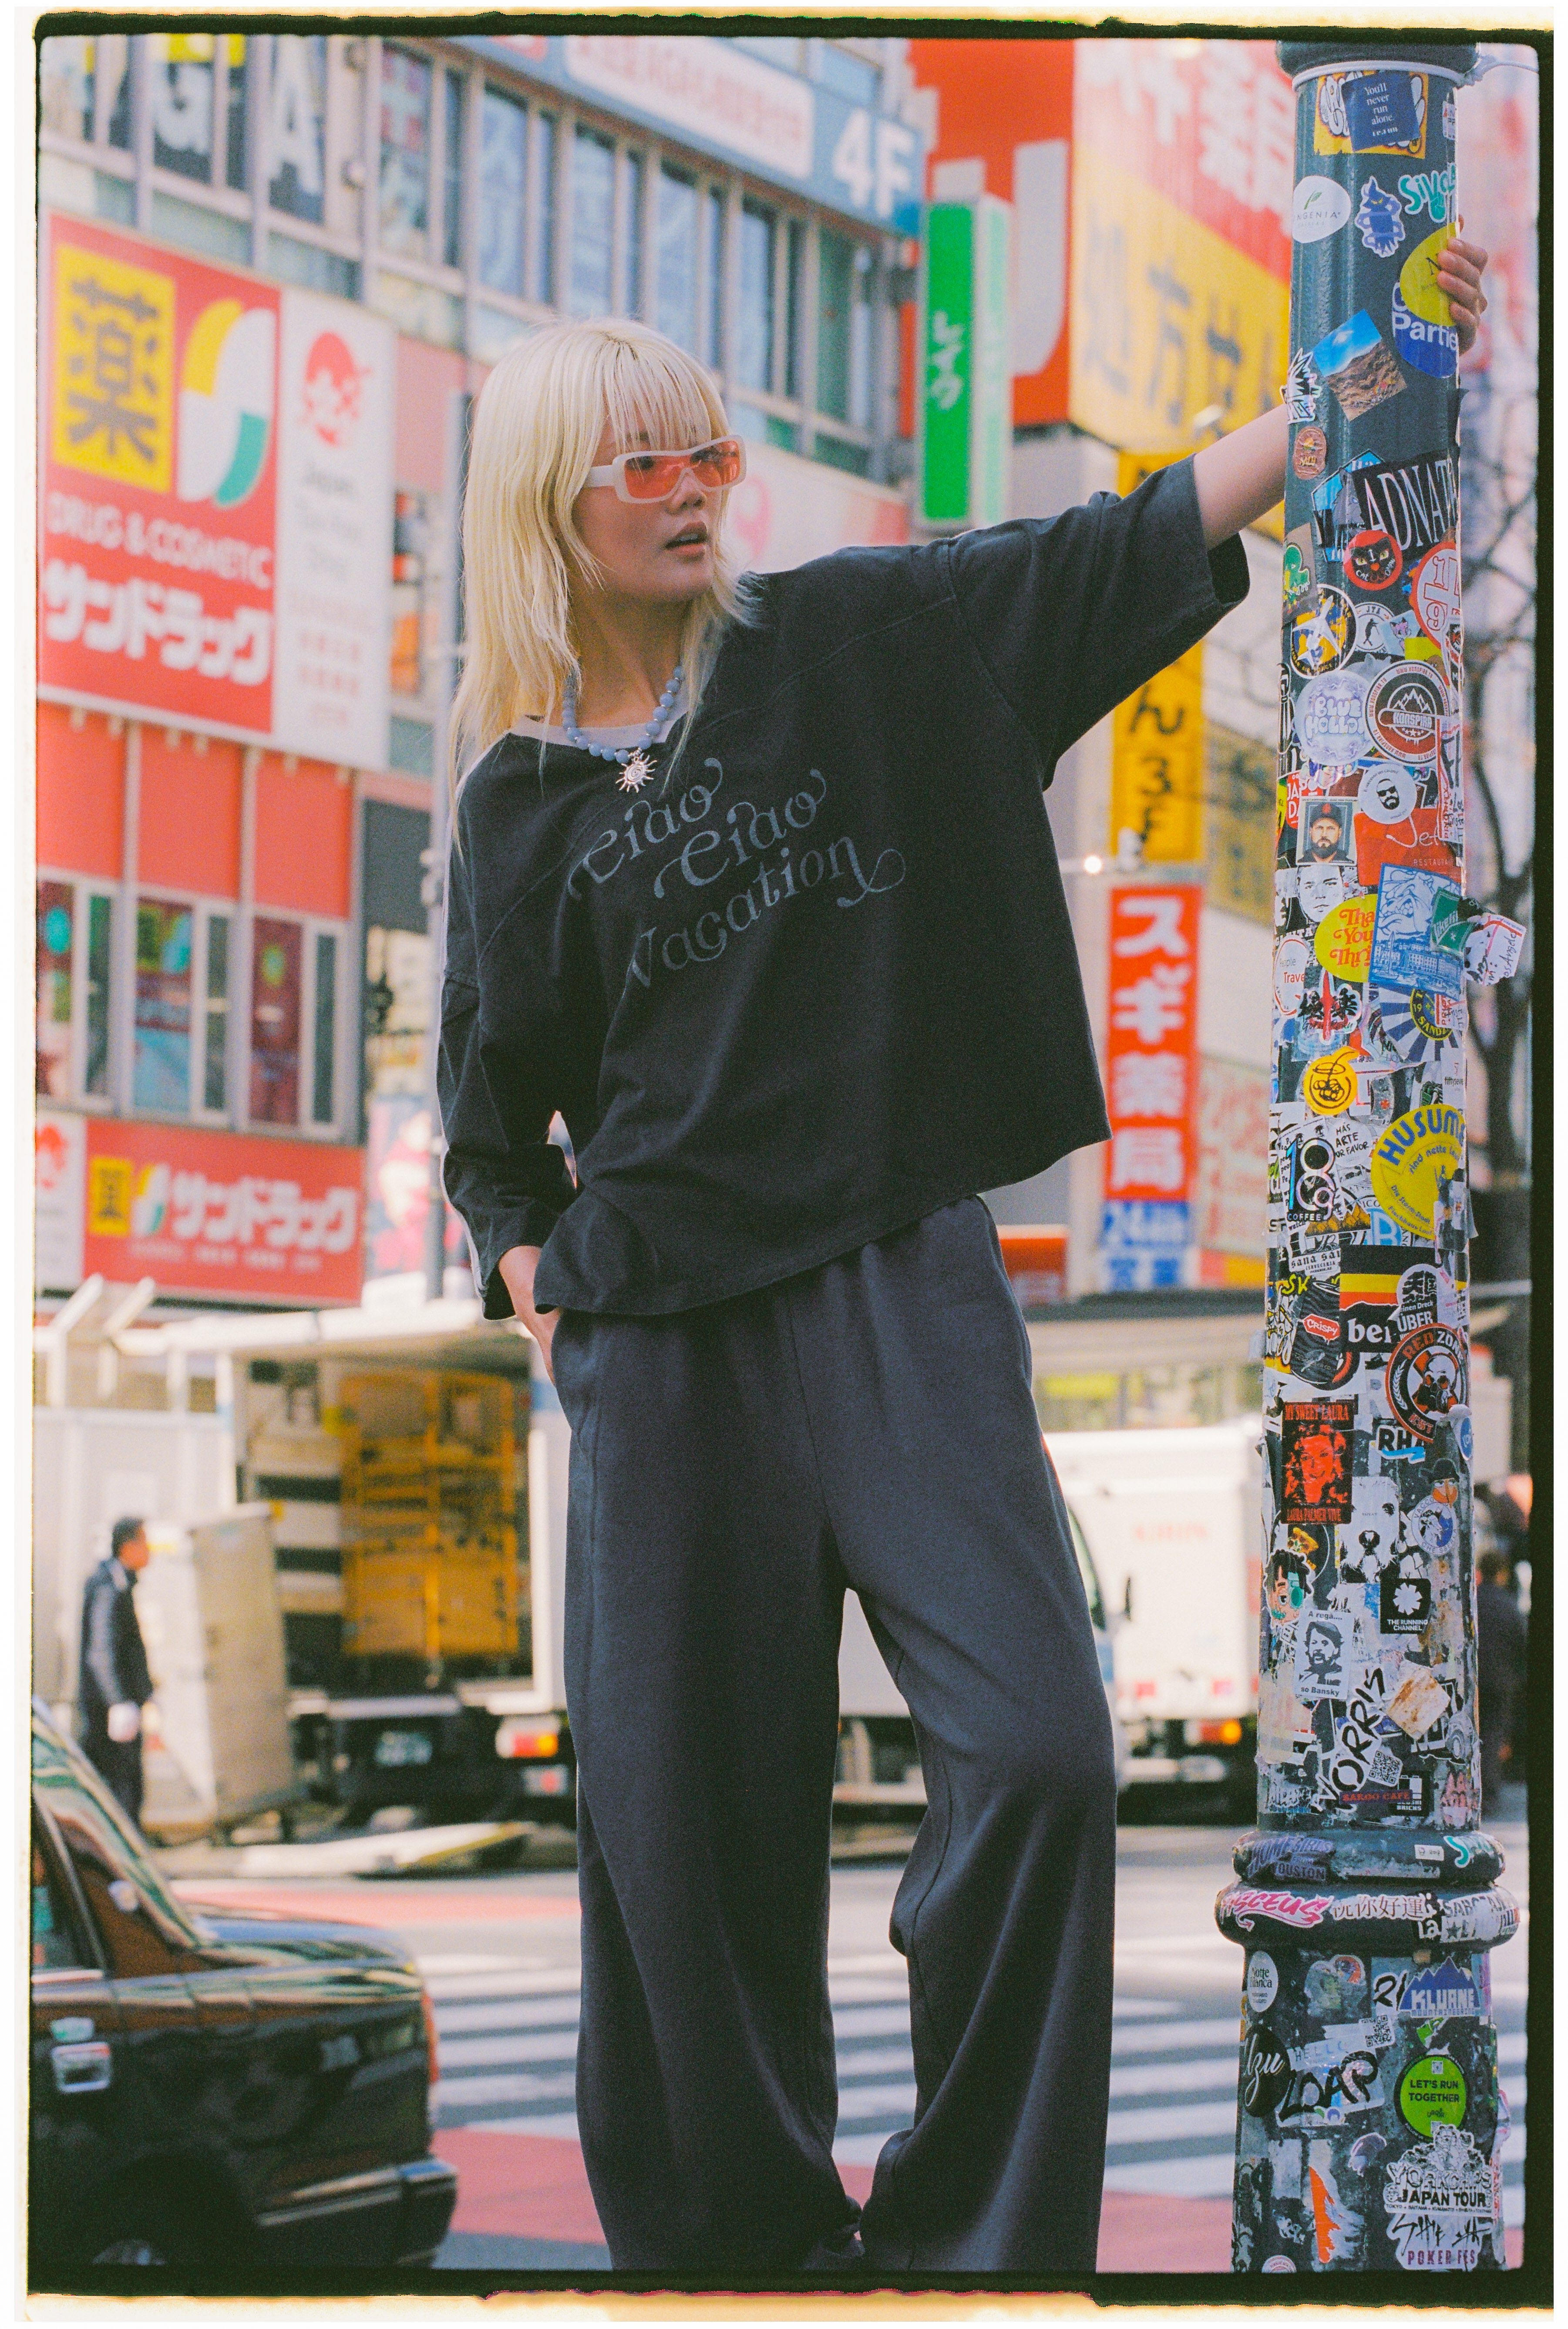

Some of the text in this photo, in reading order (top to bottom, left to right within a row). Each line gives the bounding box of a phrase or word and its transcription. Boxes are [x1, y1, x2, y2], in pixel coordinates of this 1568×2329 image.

[1367, 94, 1389, 105] never
[1373, 105, 1388, 114] run
[832, 107, 914, 219] 4F
[44, 559, 273, 687] サンドラッグ
[1314, 696, 1361, 718] BLUE
[568, 757, 724, 900] Ciao
[653, 768, 827, 899] Ciao
[614, 835, 907, 1021] Vacation
[1111, 895, 1190, 1191] スギ薬局
[1336, 1132, 1359, 1148] ARTE
[1335, 1141, 1369, 1158] OR FAVOR
[173, 1168, 358, 1253] サンドラッグ
[1288, 1213, 1321, 1221] COFFEE
[1417, 1300, 1433, 1309] Dreck
[1397, 1310, 1433, 1333] ÜBER
[1401, 1331, 1434, 1360] RED
[1296, 1404, 1319, 1420] SWEET
[1319, 1404, 1349, 1421] LAURA
[1308, 1611, 1314, 1619] A
[1311, 1687, 1340, 1698] Bansky
[1411, 1988, 1474, 2009] KLUANE
[1410, 2079, 1459, 2089] LET'S RUN
[1408, 2093, 1460, 2103] TOGETHER
[1397, 2189, 1486, 2207] JAPAN TOUR
[1407, 2250, 1452, 2265] POKER
